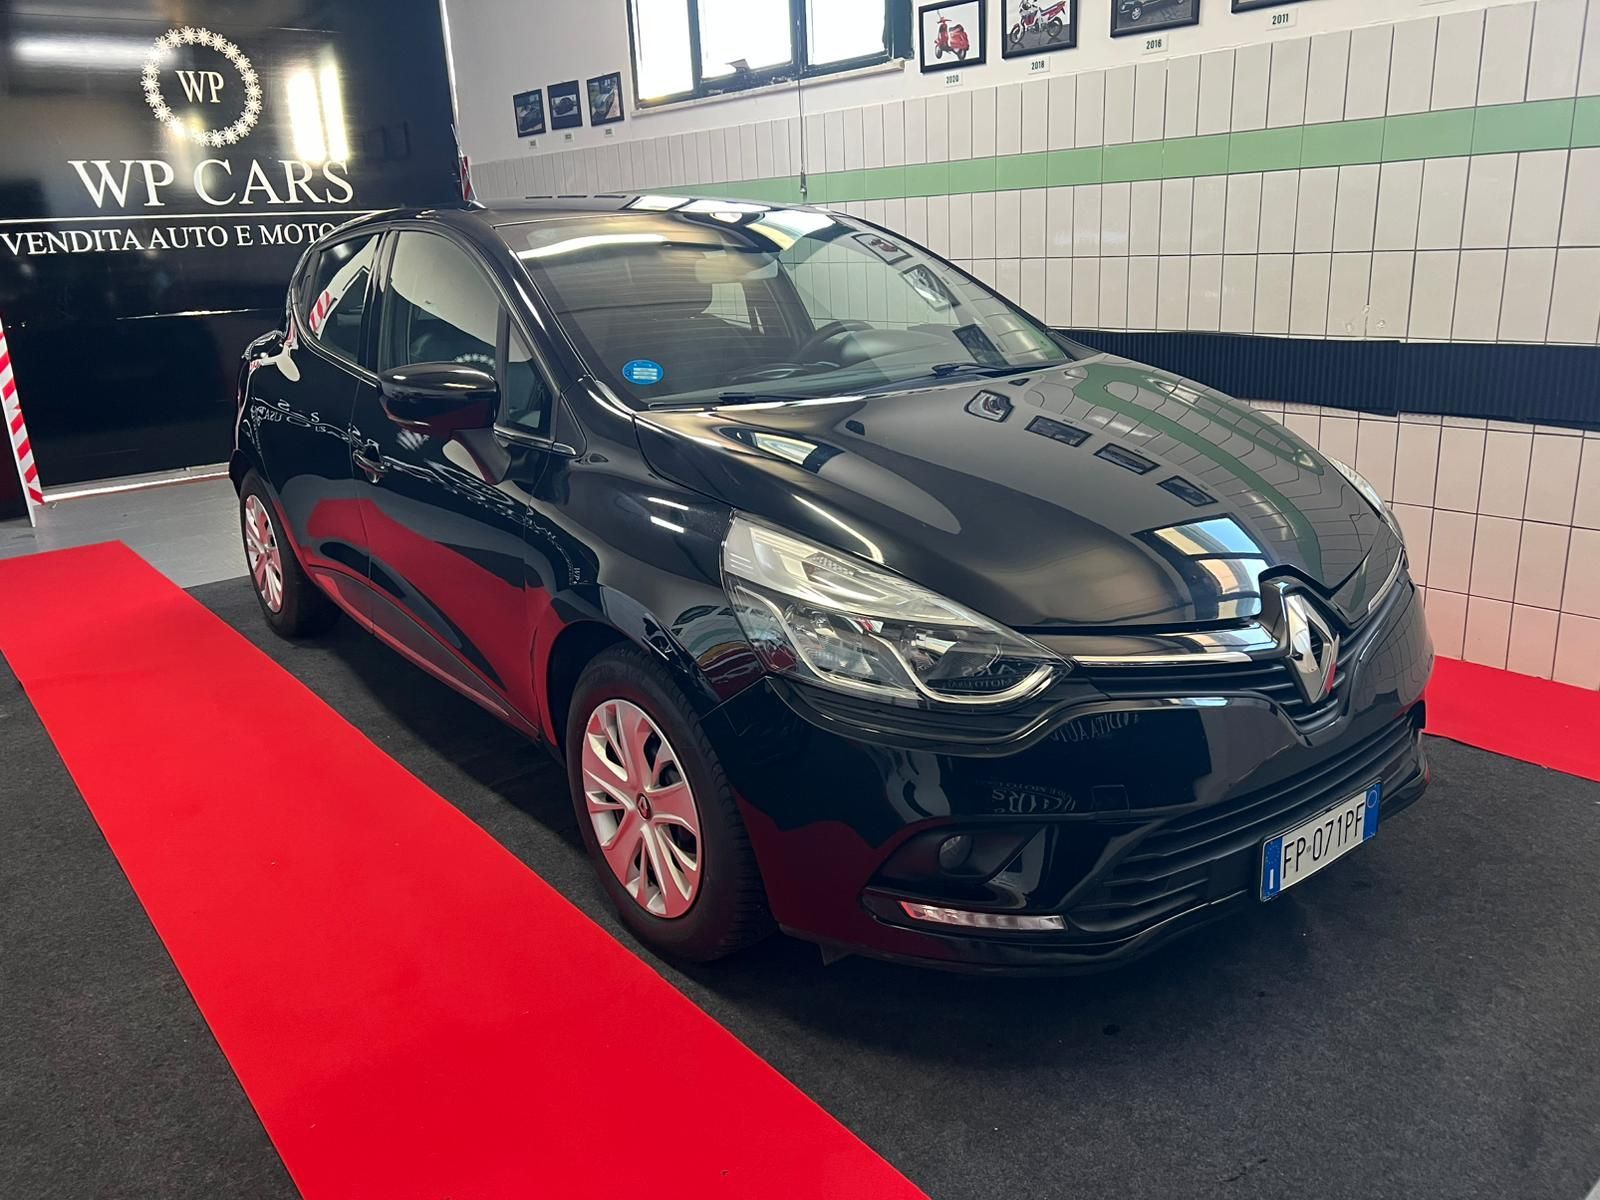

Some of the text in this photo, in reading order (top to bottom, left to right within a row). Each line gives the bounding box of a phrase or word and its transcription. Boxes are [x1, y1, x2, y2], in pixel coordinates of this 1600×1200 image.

[1272, 14, 1289, 25] 2011
[1146, 39, 1162, 50] 2016
[1031, 60, 1045, 71] 2018
[175, 70, 225, 104] WP
[68, 159, 355, 208] WP CARS
[2, 222, 336, 256] VENDITA AUTO E MOTO
[1282, 836, 1306, 880] FP
[1312, 802, 1365, 861] 071PF
